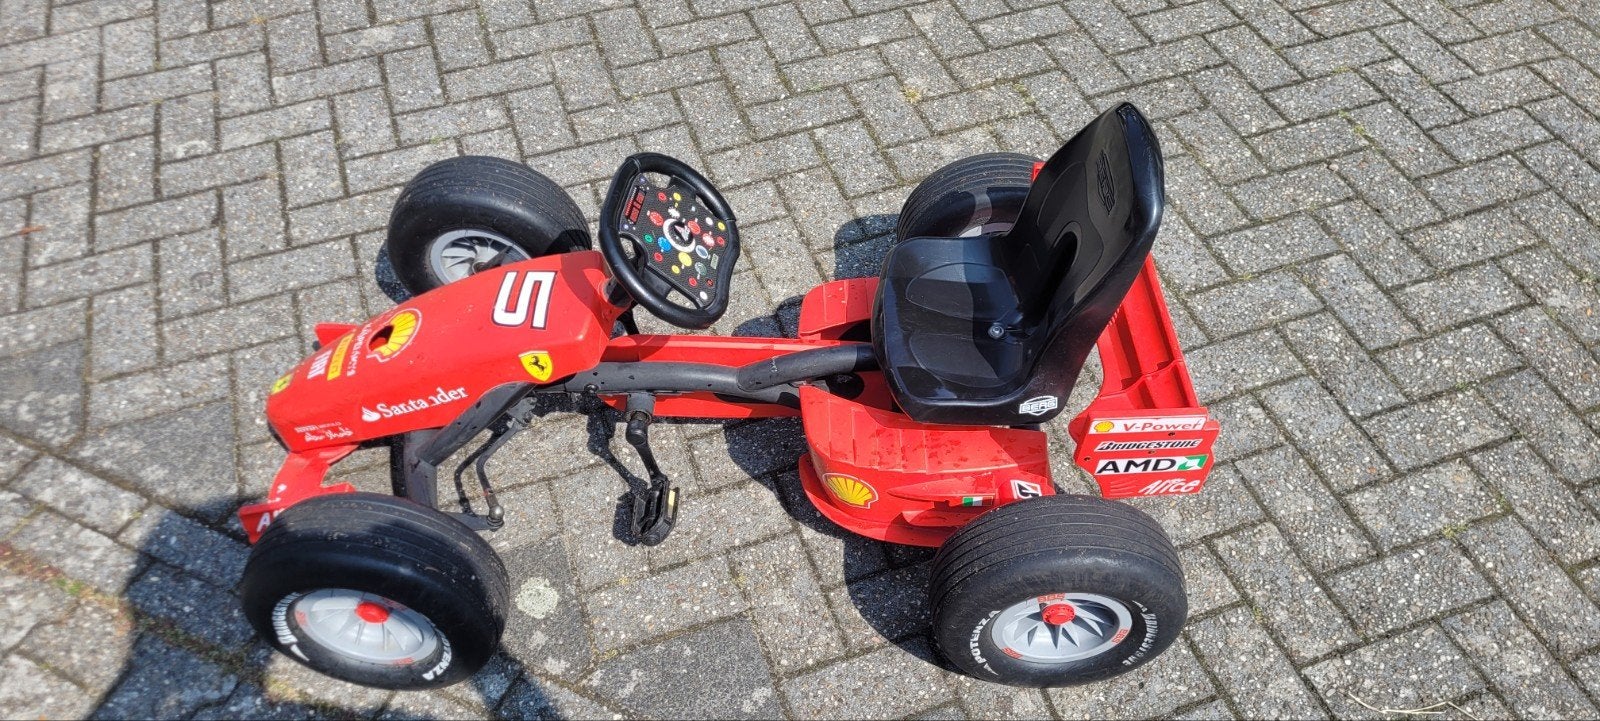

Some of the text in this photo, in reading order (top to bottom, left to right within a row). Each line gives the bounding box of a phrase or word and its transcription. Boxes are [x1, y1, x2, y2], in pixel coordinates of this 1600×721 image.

[377, 386, 468, 417] Santander
[1021, 398, 1057, 412] BERG
[1123, 418, 1202, 432] V-Power
[1097, 439, 1203, 452] BRIDGESTONE
[1096, 458, 1177, 474] AMD
[1138, 478, 1201, 495] Alice
[969, 610, 1002, 664] POTENZA
